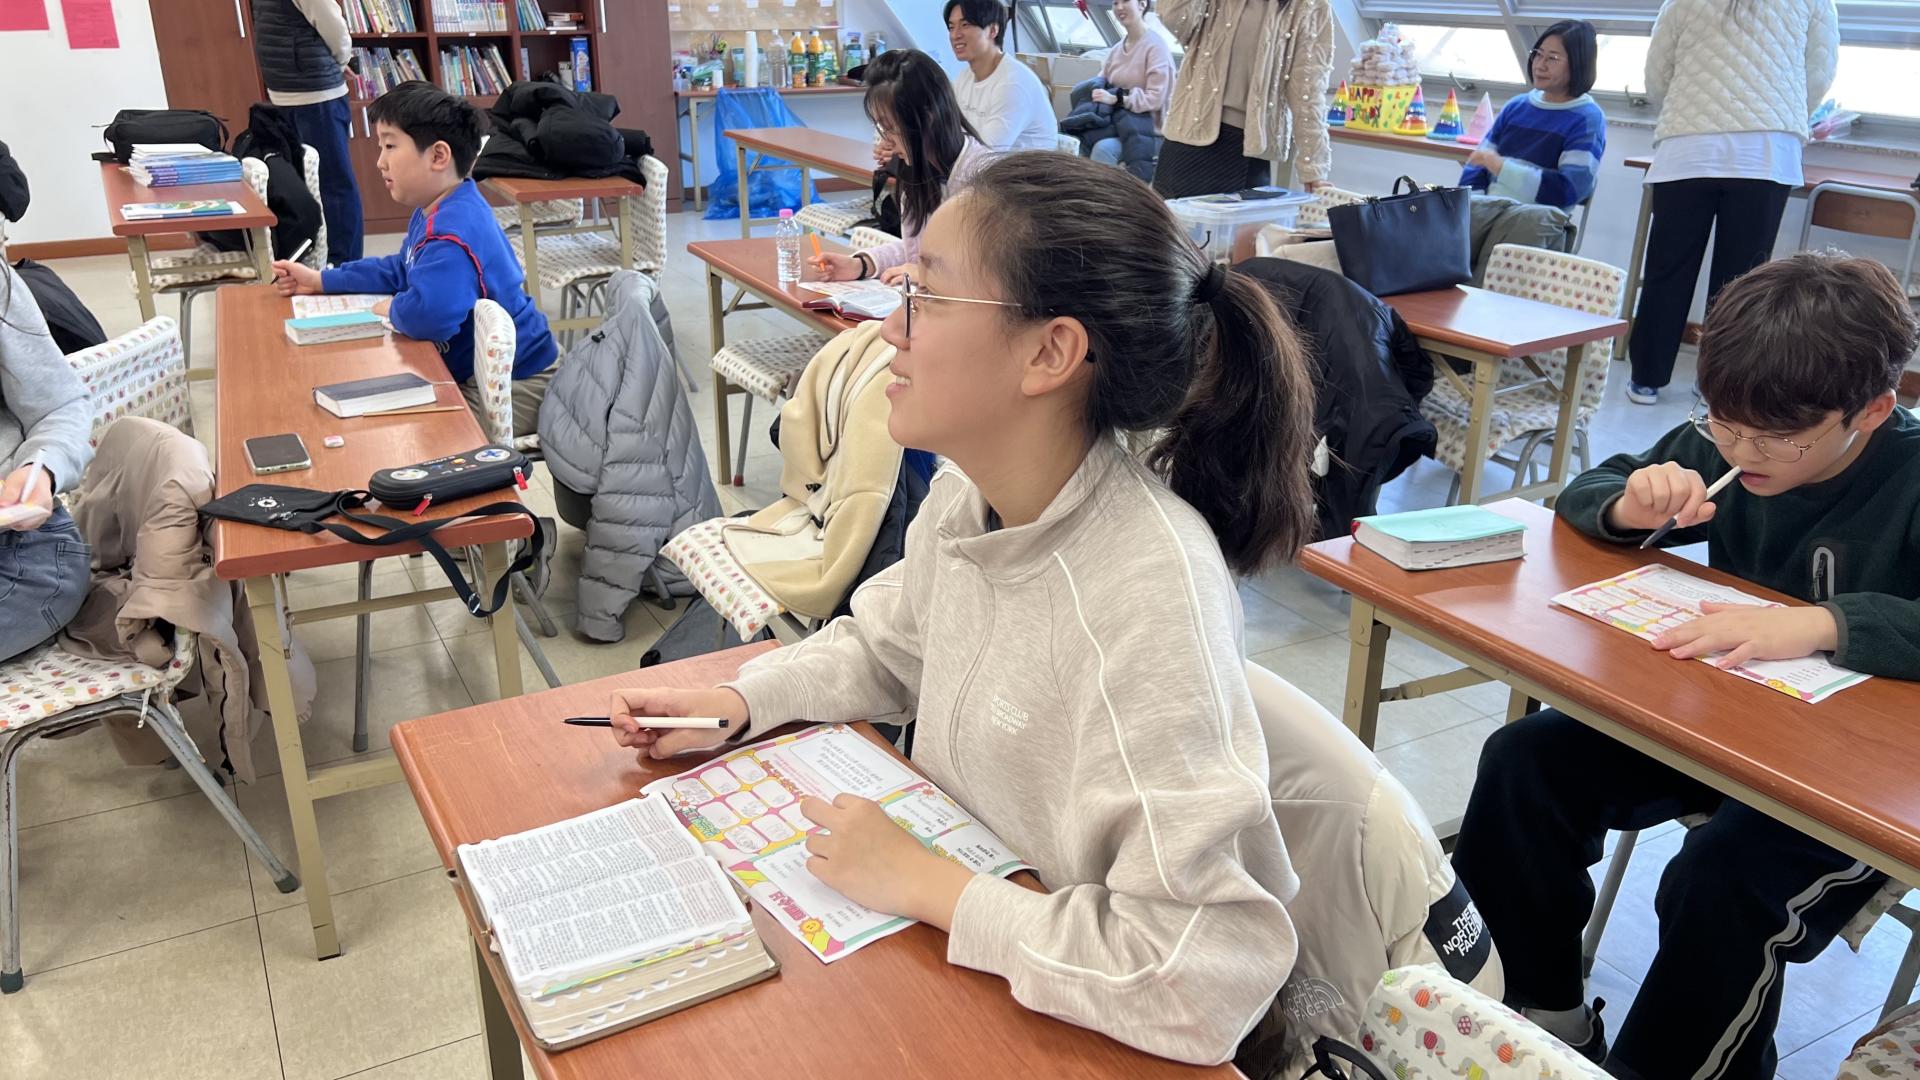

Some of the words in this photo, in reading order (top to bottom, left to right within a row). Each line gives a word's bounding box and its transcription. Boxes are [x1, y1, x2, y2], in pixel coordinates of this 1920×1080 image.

[1349, 87, 1381, 103] HAPPY
[1452, 907, 1471, 930] THE
[1442, 918, 1477, 955] NORTH
[1458, 926, 1480, 956] FACE
[1288, 979, 1312, 995] THE
[1293, 1001, 1323, 1023] FACE
